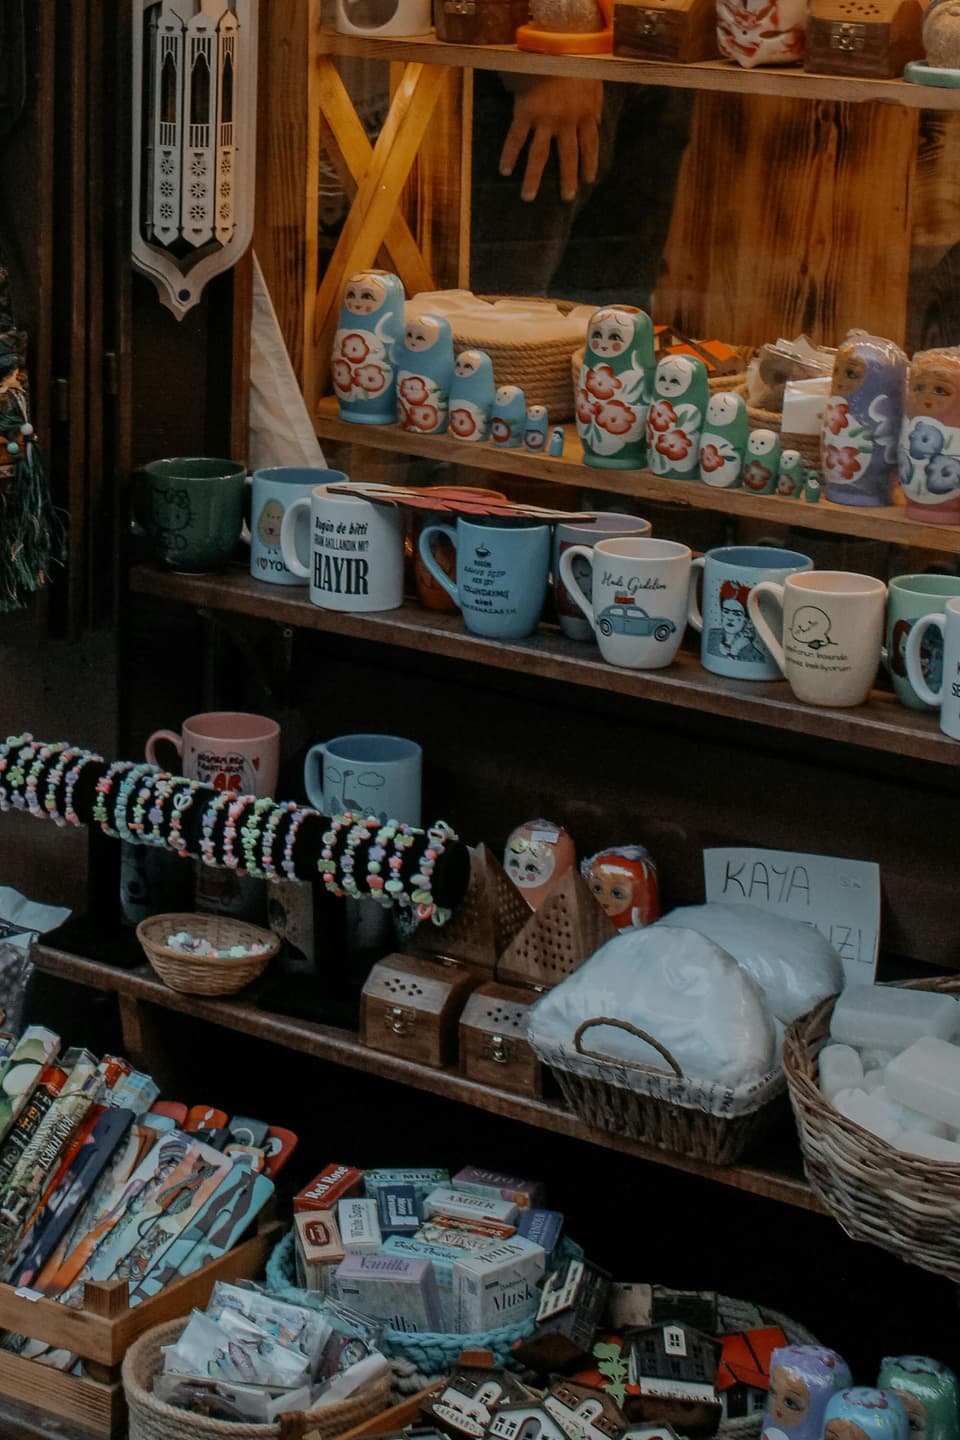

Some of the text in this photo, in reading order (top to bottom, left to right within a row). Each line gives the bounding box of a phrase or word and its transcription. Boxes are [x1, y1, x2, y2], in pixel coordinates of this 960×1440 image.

[336, 522, 346, 534] de
[349, 522, 368, 535] bitti
[314, 551, 369, 595] HAYIR
[723, 860, 810, 905] KAYA
[36, 1114, 75, 1170] RAIN FOREST
[304, 1165, 349, 1200] Red Rose
[402, 1172, 442, 1182] MINT
[360, 1257, 411, 1271] Vanilla
[493, 1283, 534, 1311] Musk
